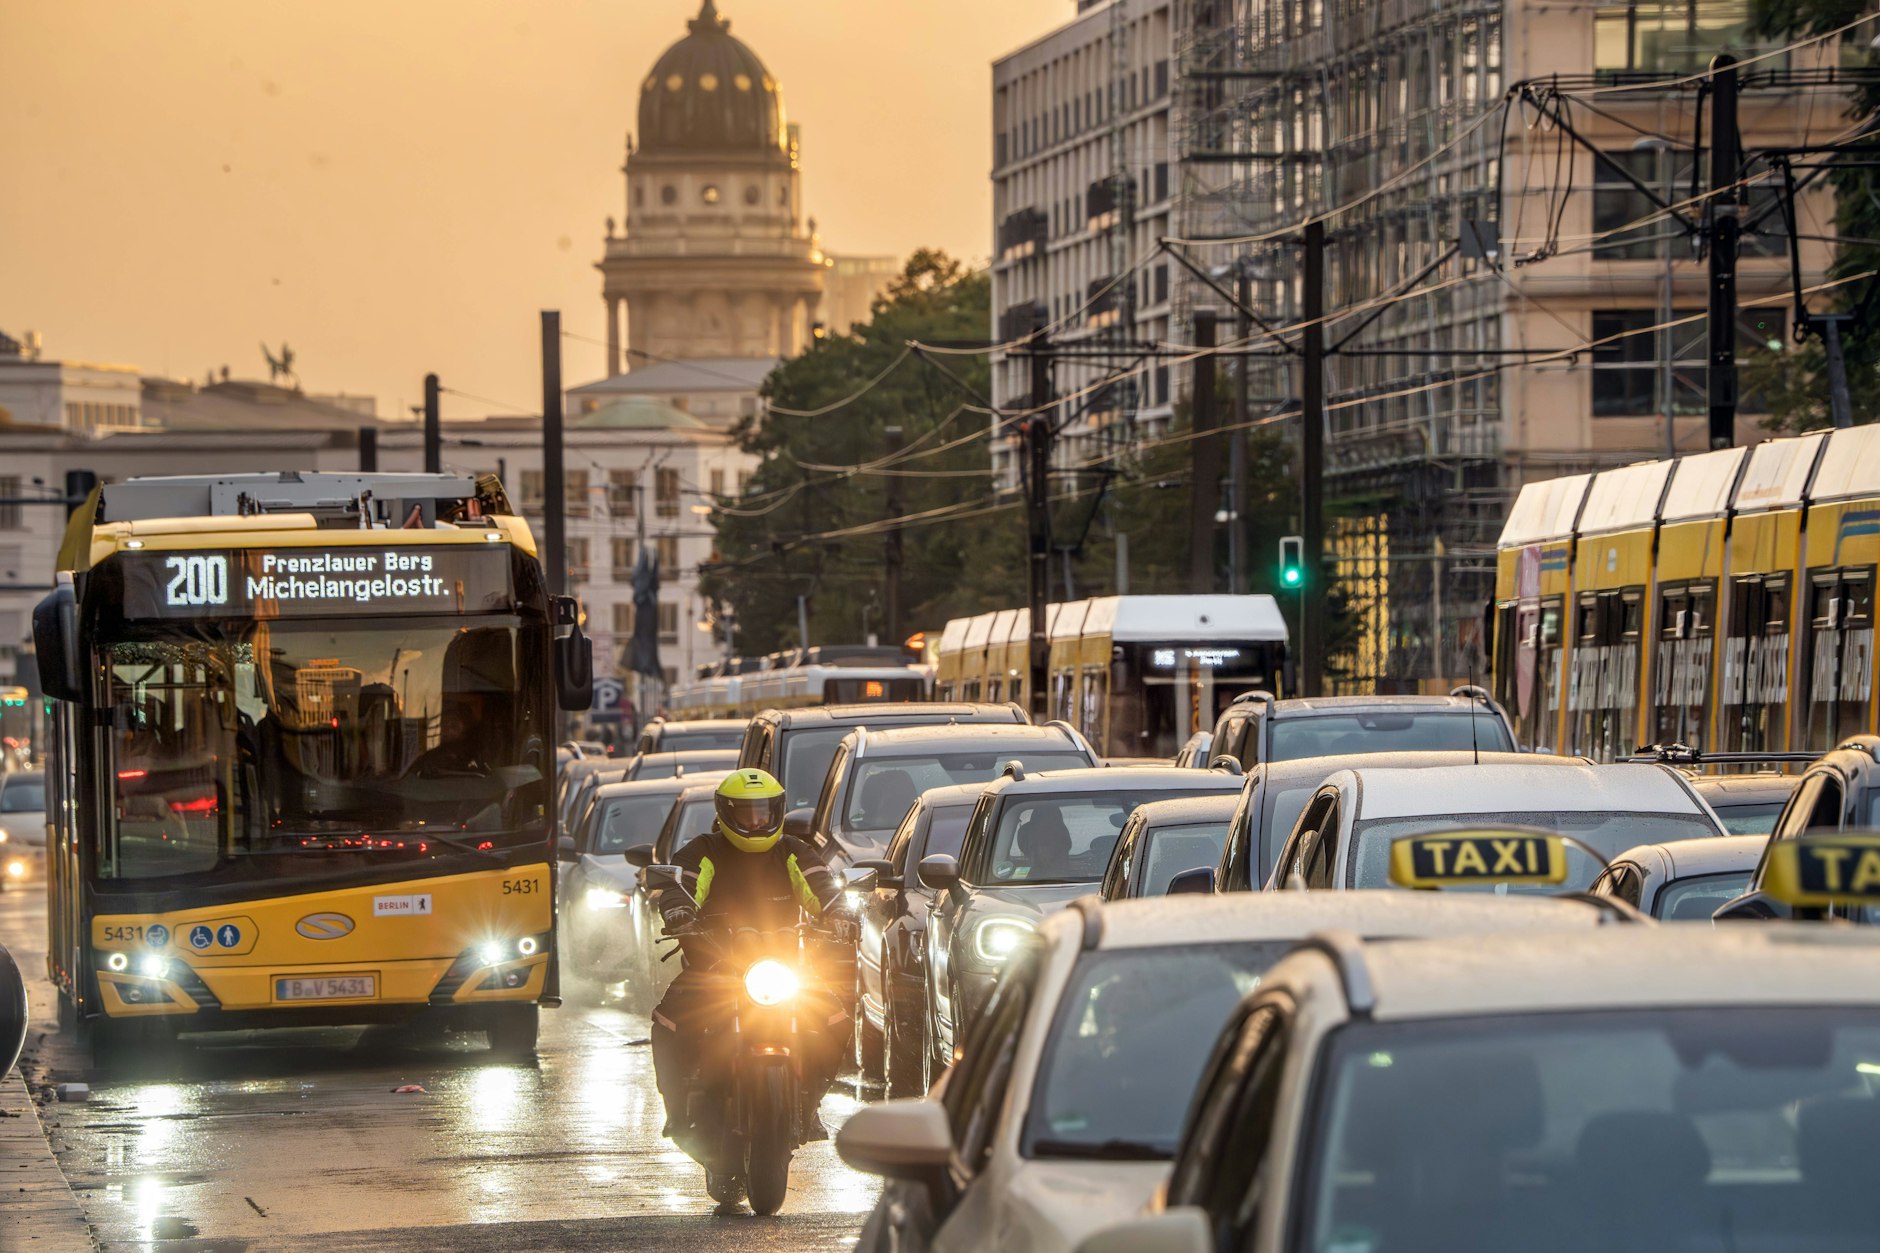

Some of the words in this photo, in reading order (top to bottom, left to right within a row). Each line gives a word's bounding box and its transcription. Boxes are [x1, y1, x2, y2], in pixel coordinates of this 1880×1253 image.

[263, 553, 377, 573] Prenzlauer
[384, 552, 433, 571] Berg
[166, 555, 228, 605] 200
[247, 574, 450, 601] Michelangelostr.
[599, 687, 618, 711] P
[1422, 840, 1539, 875] TAXI
[1810, 847, 1880, 892] TA
[502, 879, 539, 895] 5431
[378, 901, 409, 911] BERLIN
[104, 926, 143, 942] 5431
[292, 981, 302, 996] B
[327, 979, 368, 996] 5431
